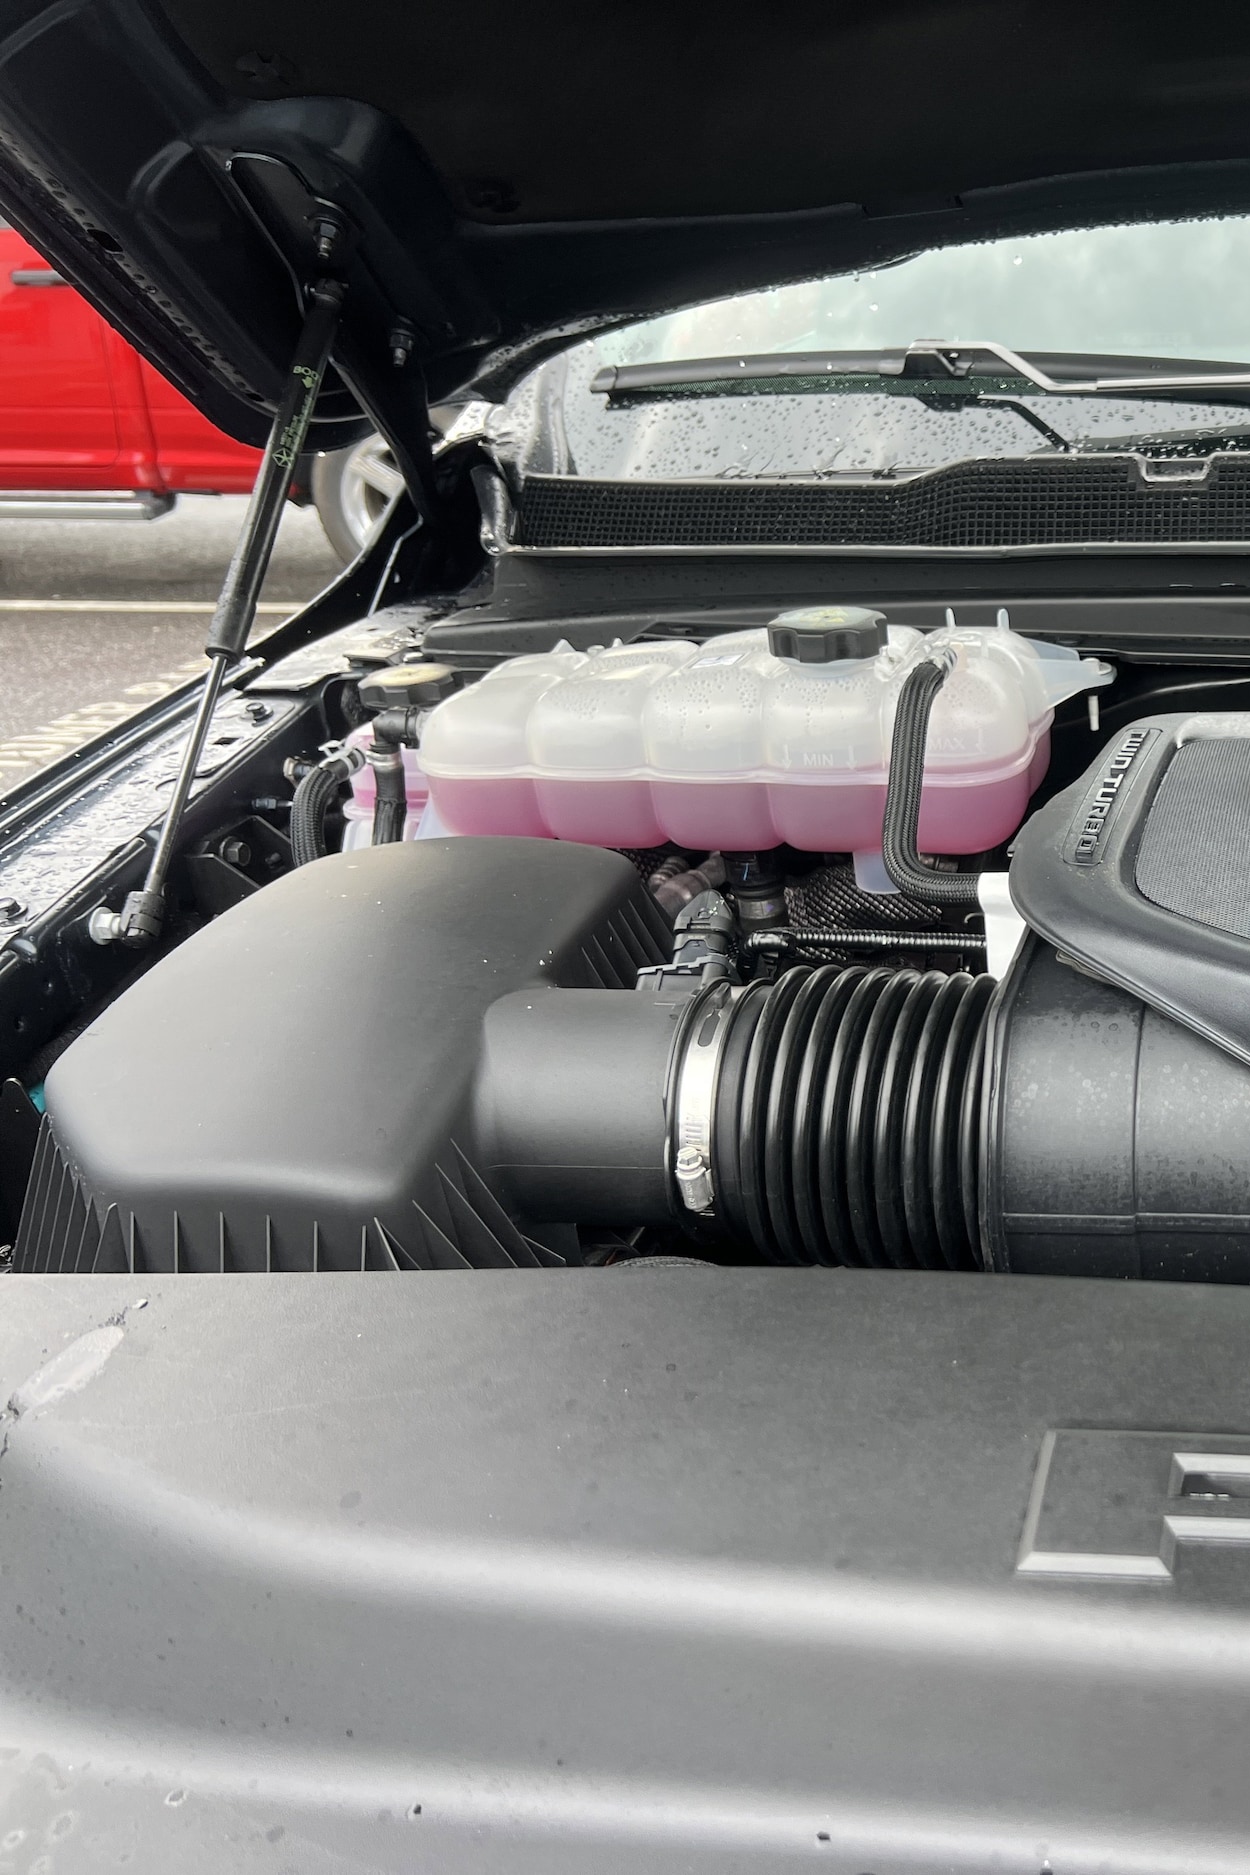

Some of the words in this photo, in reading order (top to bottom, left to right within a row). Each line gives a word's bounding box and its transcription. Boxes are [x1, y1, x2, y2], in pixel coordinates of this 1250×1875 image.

[929, 737, 965, 750] MAX
[1111, 728, 1150, 772] TWIN
[803, 753, 833, 766] MIN
[1075, 773, 1124, 859] TURBO
